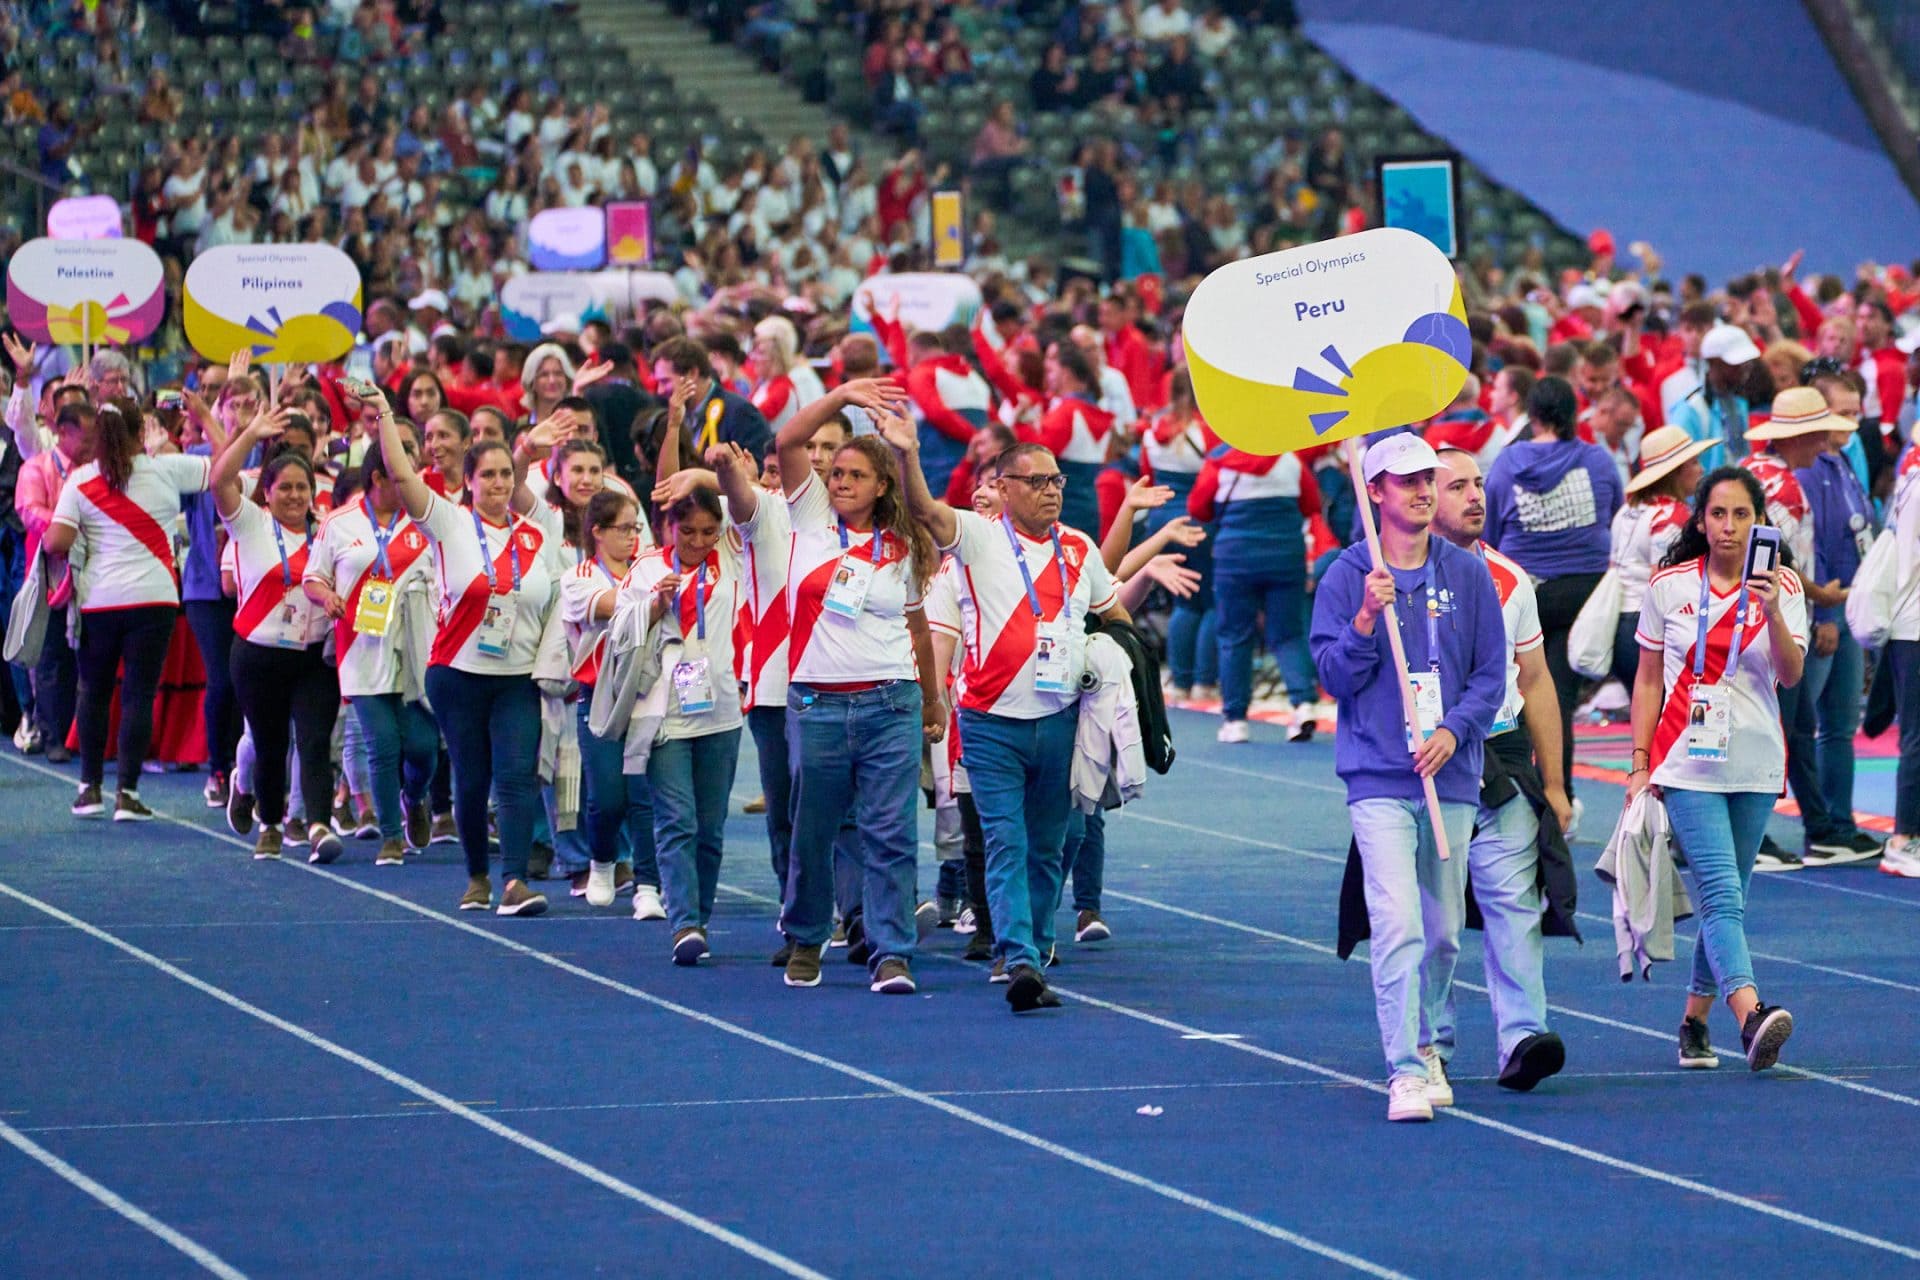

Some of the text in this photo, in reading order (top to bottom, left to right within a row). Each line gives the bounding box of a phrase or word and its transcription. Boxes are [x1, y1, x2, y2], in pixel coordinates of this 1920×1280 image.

[57, 266, 114, 278] Palestine
[1255, 252, 1366, 286] Special Olympics
[242, 276, 303, 292] Pilipinas
[1294, 299, 1346, 321] Peru
